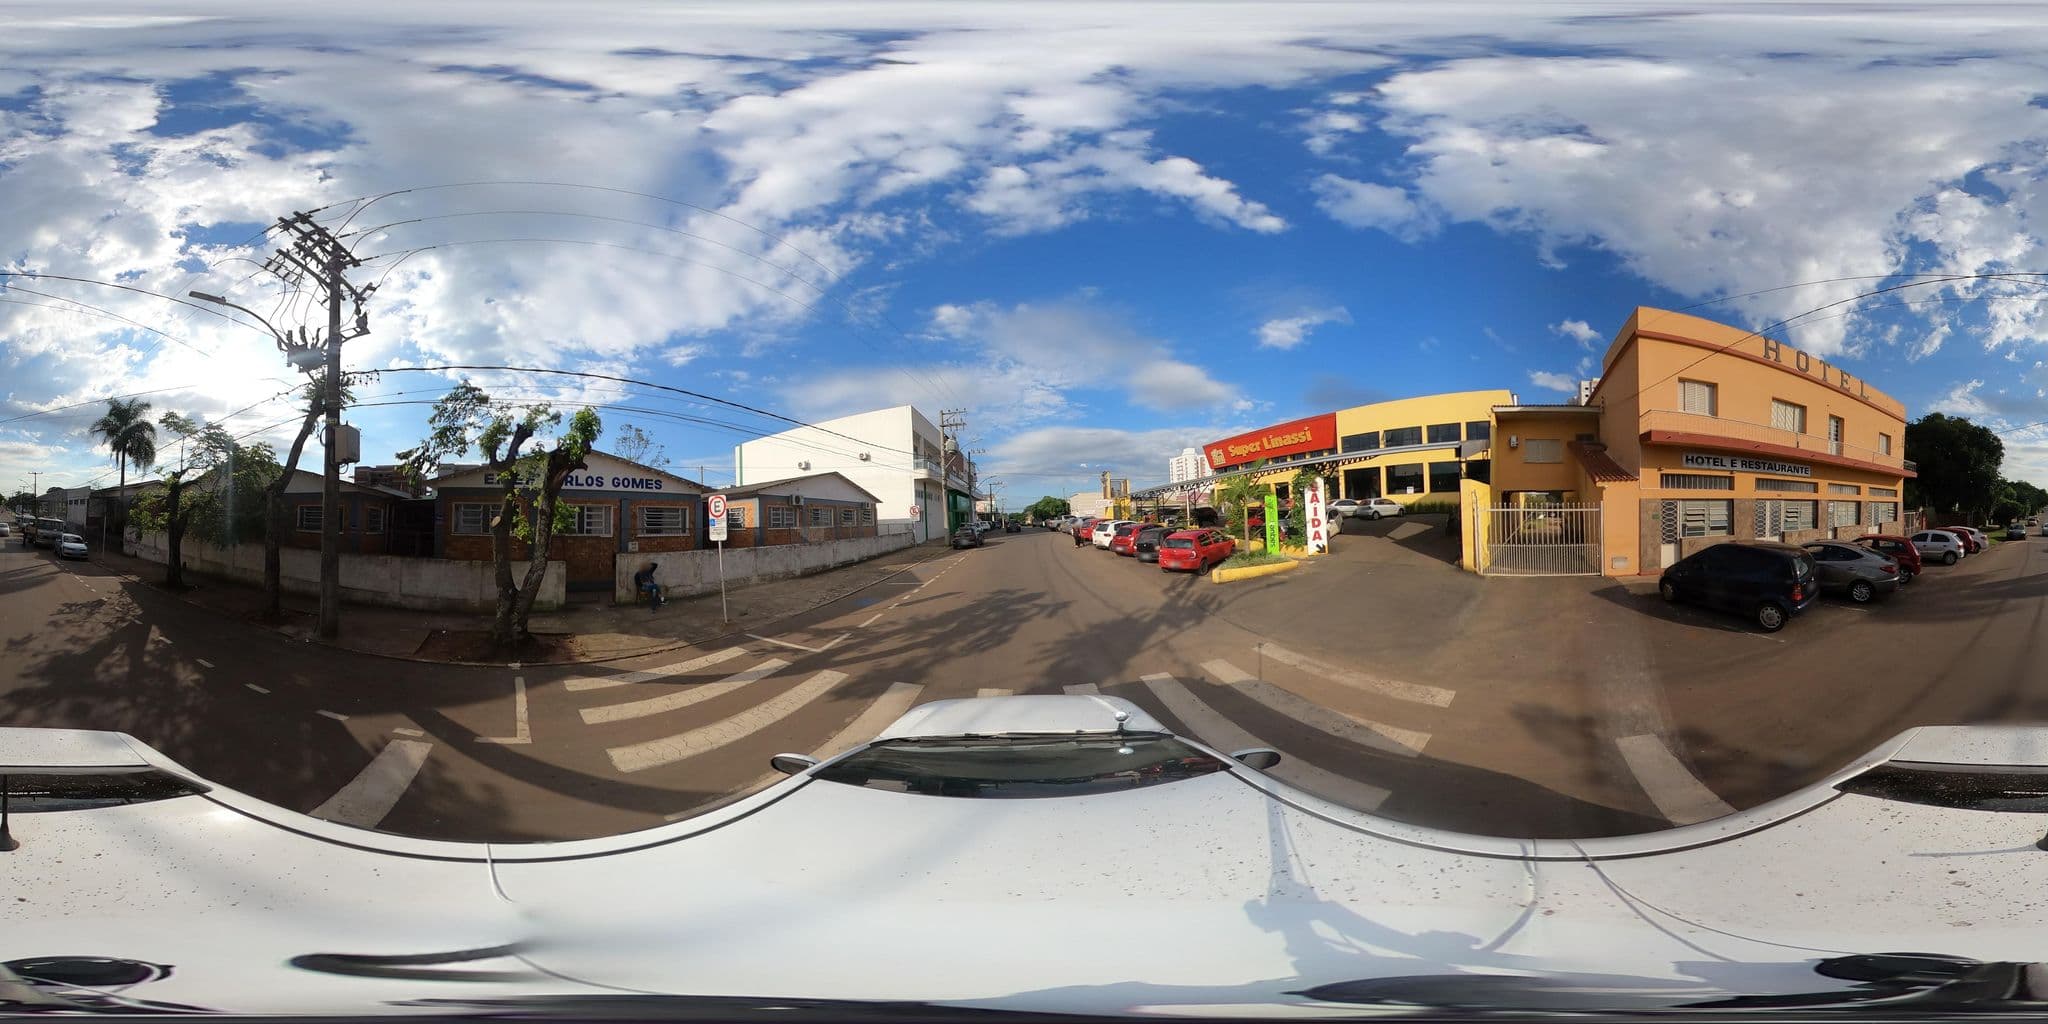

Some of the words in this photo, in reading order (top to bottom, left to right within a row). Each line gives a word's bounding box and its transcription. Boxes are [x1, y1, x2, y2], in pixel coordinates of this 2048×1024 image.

[1763, 337, 1869, 401] HOTEL
[1228, 441, 1261, 457] Super
[1263, 426, 1313, 449] Linassi
[1685, 455, 1727, 467] HOTEL
[1730, 459, 1738, 468] E
[1740, 460, 1810, 475] RESTAURANTE
[563, 474, 605, 488] RLOS
[611, 476, 663, 490] GOMES
[714, 501, 721, 513] E
